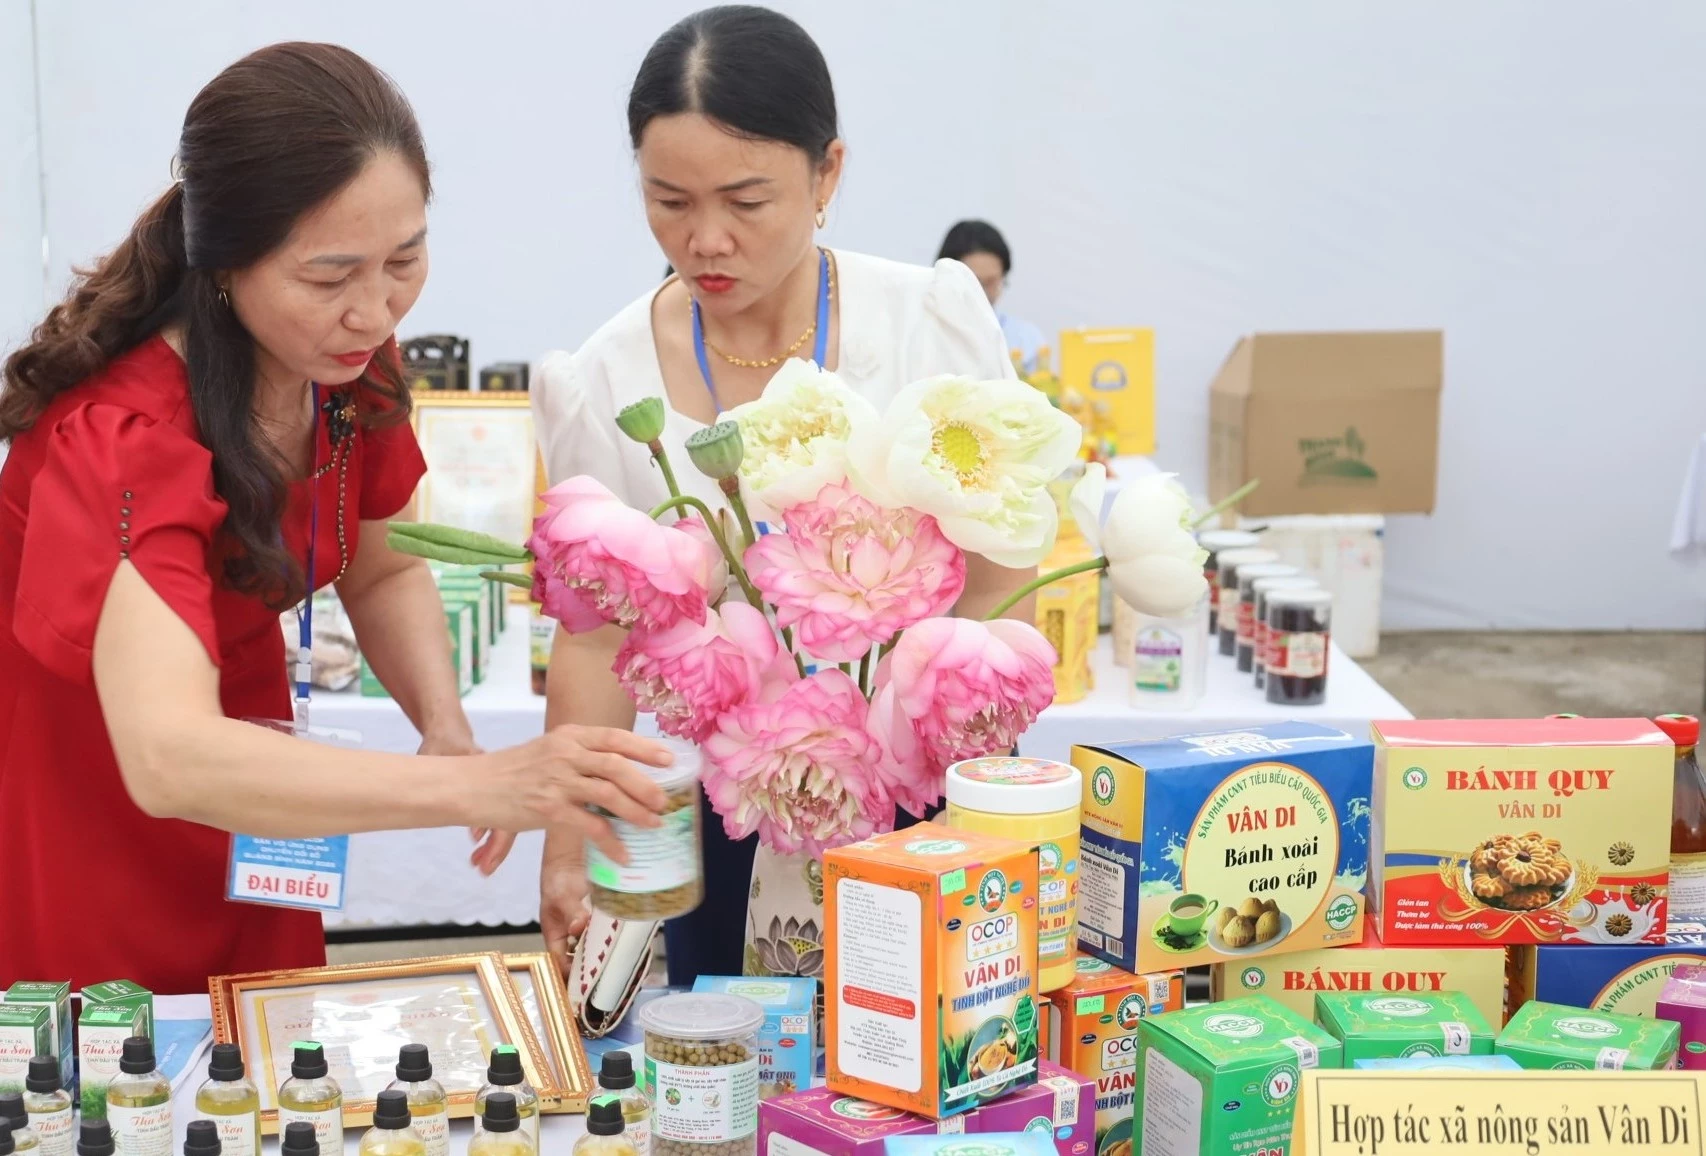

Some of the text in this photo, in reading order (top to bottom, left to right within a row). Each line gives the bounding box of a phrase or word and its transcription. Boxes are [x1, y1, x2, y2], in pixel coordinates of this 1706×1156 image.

[1446, 765, 1615, 797] BÁNH QUY
[1316, 807, 1328, 824] GIA
[1498, 800, 1562, 819] VÂN DI
[1226, 805, 1296, 834] VÂN DI
[1224, 836, 1319, 868] Bánh xoài
[247, 873, 328, 898] ĐẠI BIỂU
[1248, 863, 1318, 894] cao cấp
[1053, 916, 1066, 928] DI
[1326, 903, 1358, 922] HACCP
[971, 916, 1014, 942] OCOP
[1465, 922, 1489, 930] 100%
[964, 956, 1021, 988] VÂN DI
[1283, 965, 1448, 992] BÁNH QUY
[1634, 967, 1660, 985] CNNT
[952, 995, 976, 1012] TINH
[976, 986, 994, 1006] BỘT
[995, 976, 1018, 999] NGHỆ
[1207, 1017, 1257, 1033] HACCP
[1555, 1020, 1621, 1034] HACCP
[11, 1044, 32, 1055] Sơn
[82, 1043, 105, 1055] Thu
[1098, 1072, 1136, 1093] VÂN
[1111, 1094, 1130, 1111] BỘT
[35, 1120, 60, 1132] Thu
[130, 1115, 155, 1127] Thu
[221, 1125, 244, 1134] Sơn
[1330, 1103, 1385, 1155] Hợp
[1393, 1103, 1430, 1145] tác
[1439, 1104, 1469, 1145] xã
[1477, 1103, 1540, 1156] nông
[1547, 1103, 1591, 1145] sản
[1597, 1104, 1651, 1146] Vân
[1660, 1105, 1690, 1146] Di
